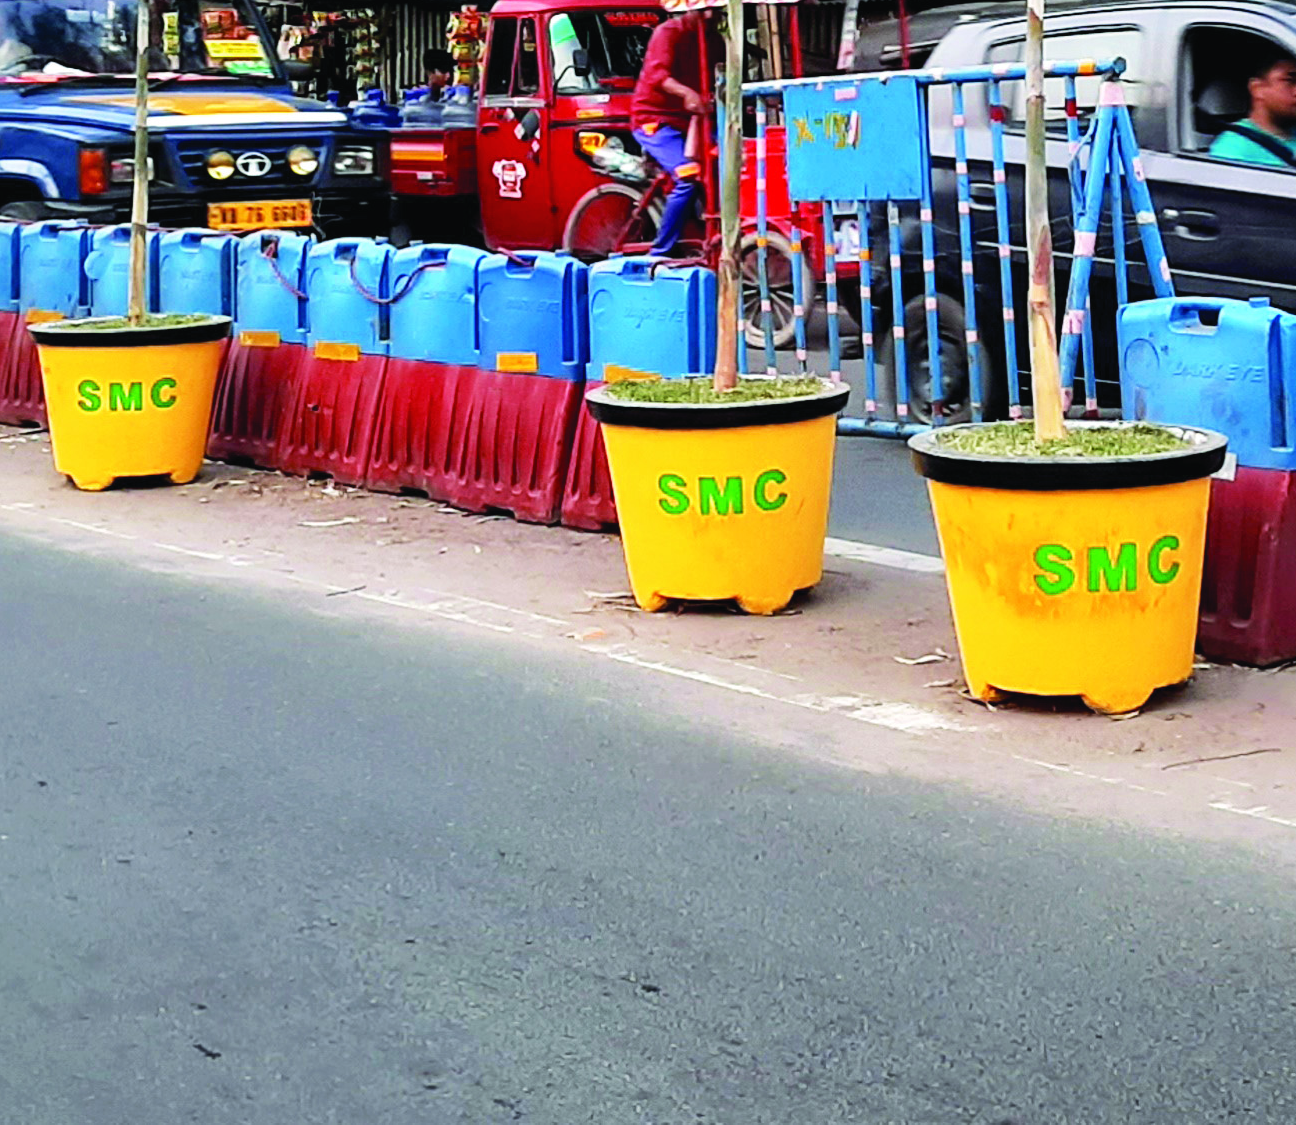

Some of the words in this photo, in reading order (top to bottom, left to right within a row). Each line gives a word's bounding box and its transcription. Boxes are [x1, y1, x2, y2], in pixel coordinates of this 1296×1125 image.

[77, 377, 178, 412] SMC
[658, 468, 788, 516] SMC
[1033, 534, 1180, 596] SMC
